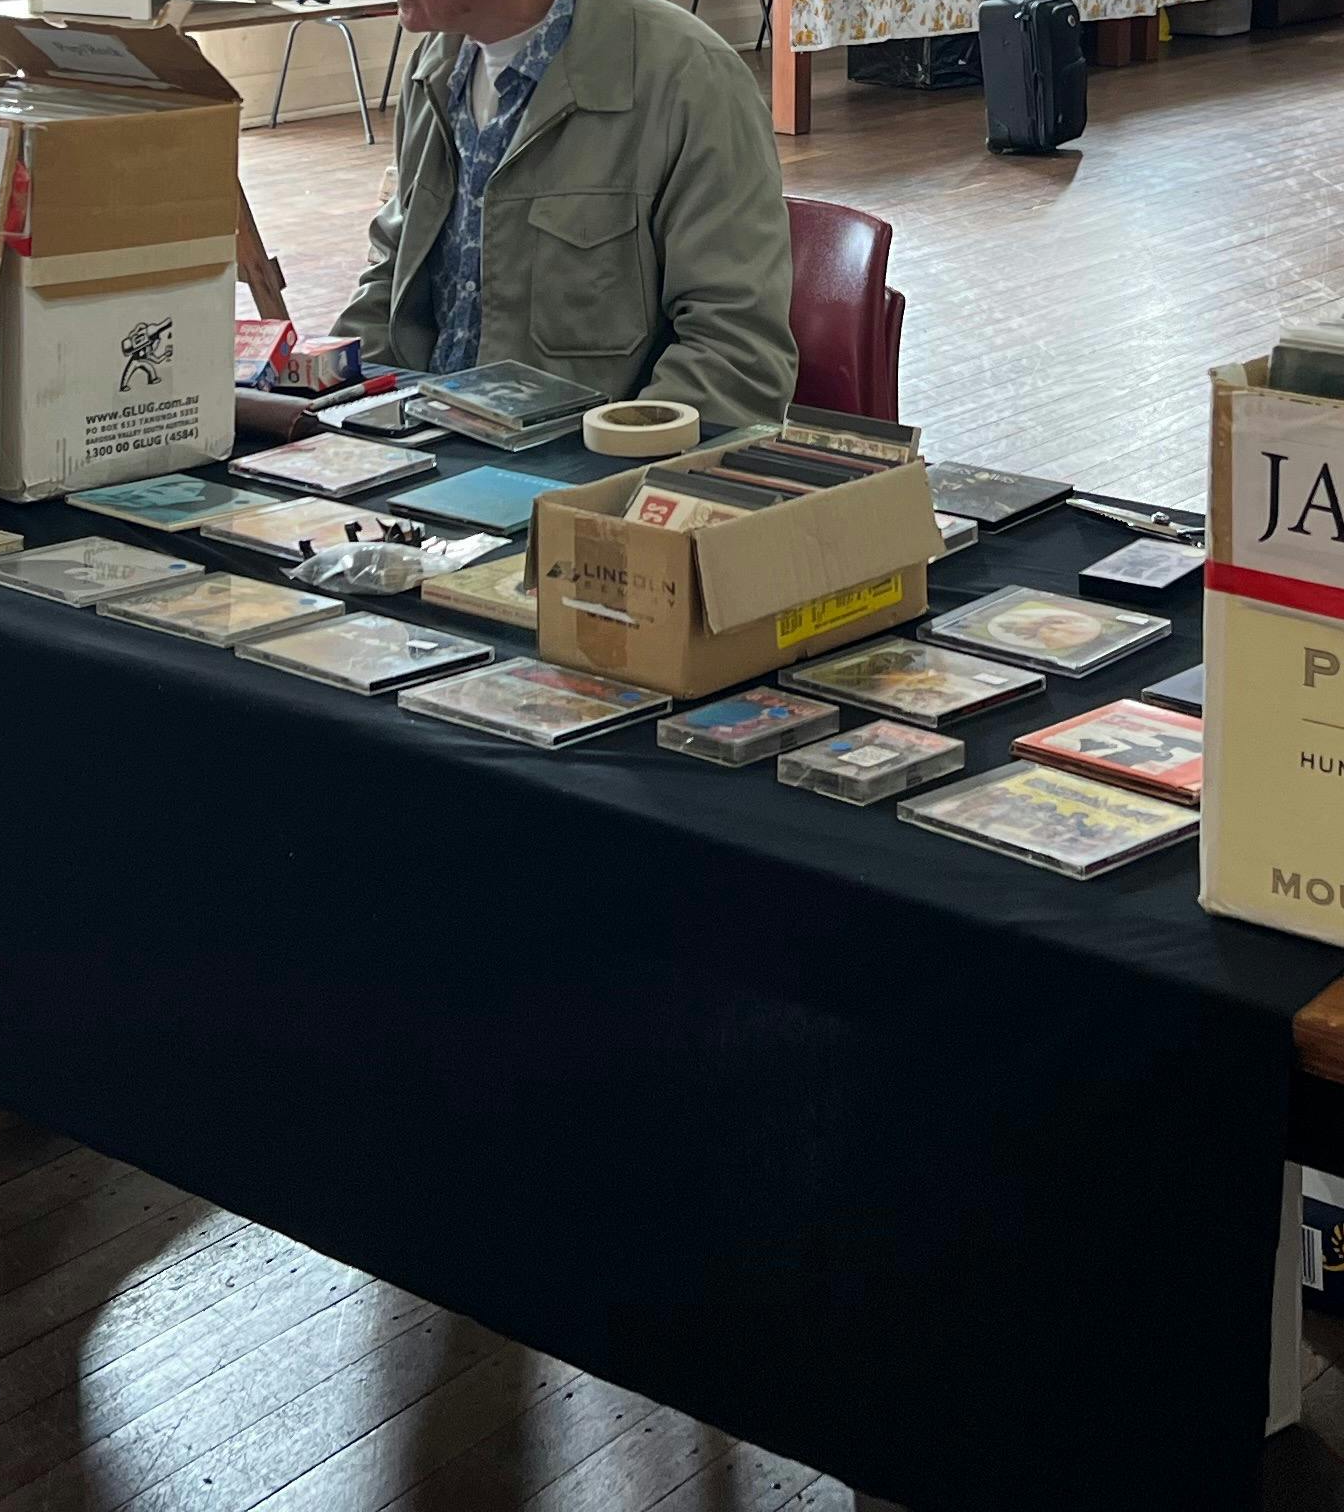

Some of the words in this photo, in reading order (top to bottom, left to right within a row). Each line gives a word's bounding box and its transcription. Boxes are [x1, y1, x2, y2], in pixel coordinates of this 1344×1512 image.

[85, 395, 200, 425] www.GLUG.com.au
[86, 445, 113, 460] 1300
[116, 442, 130, 453] 00
[132, 436, 161, 450] GLUG
[165, 427, 199, 445] (4584)
